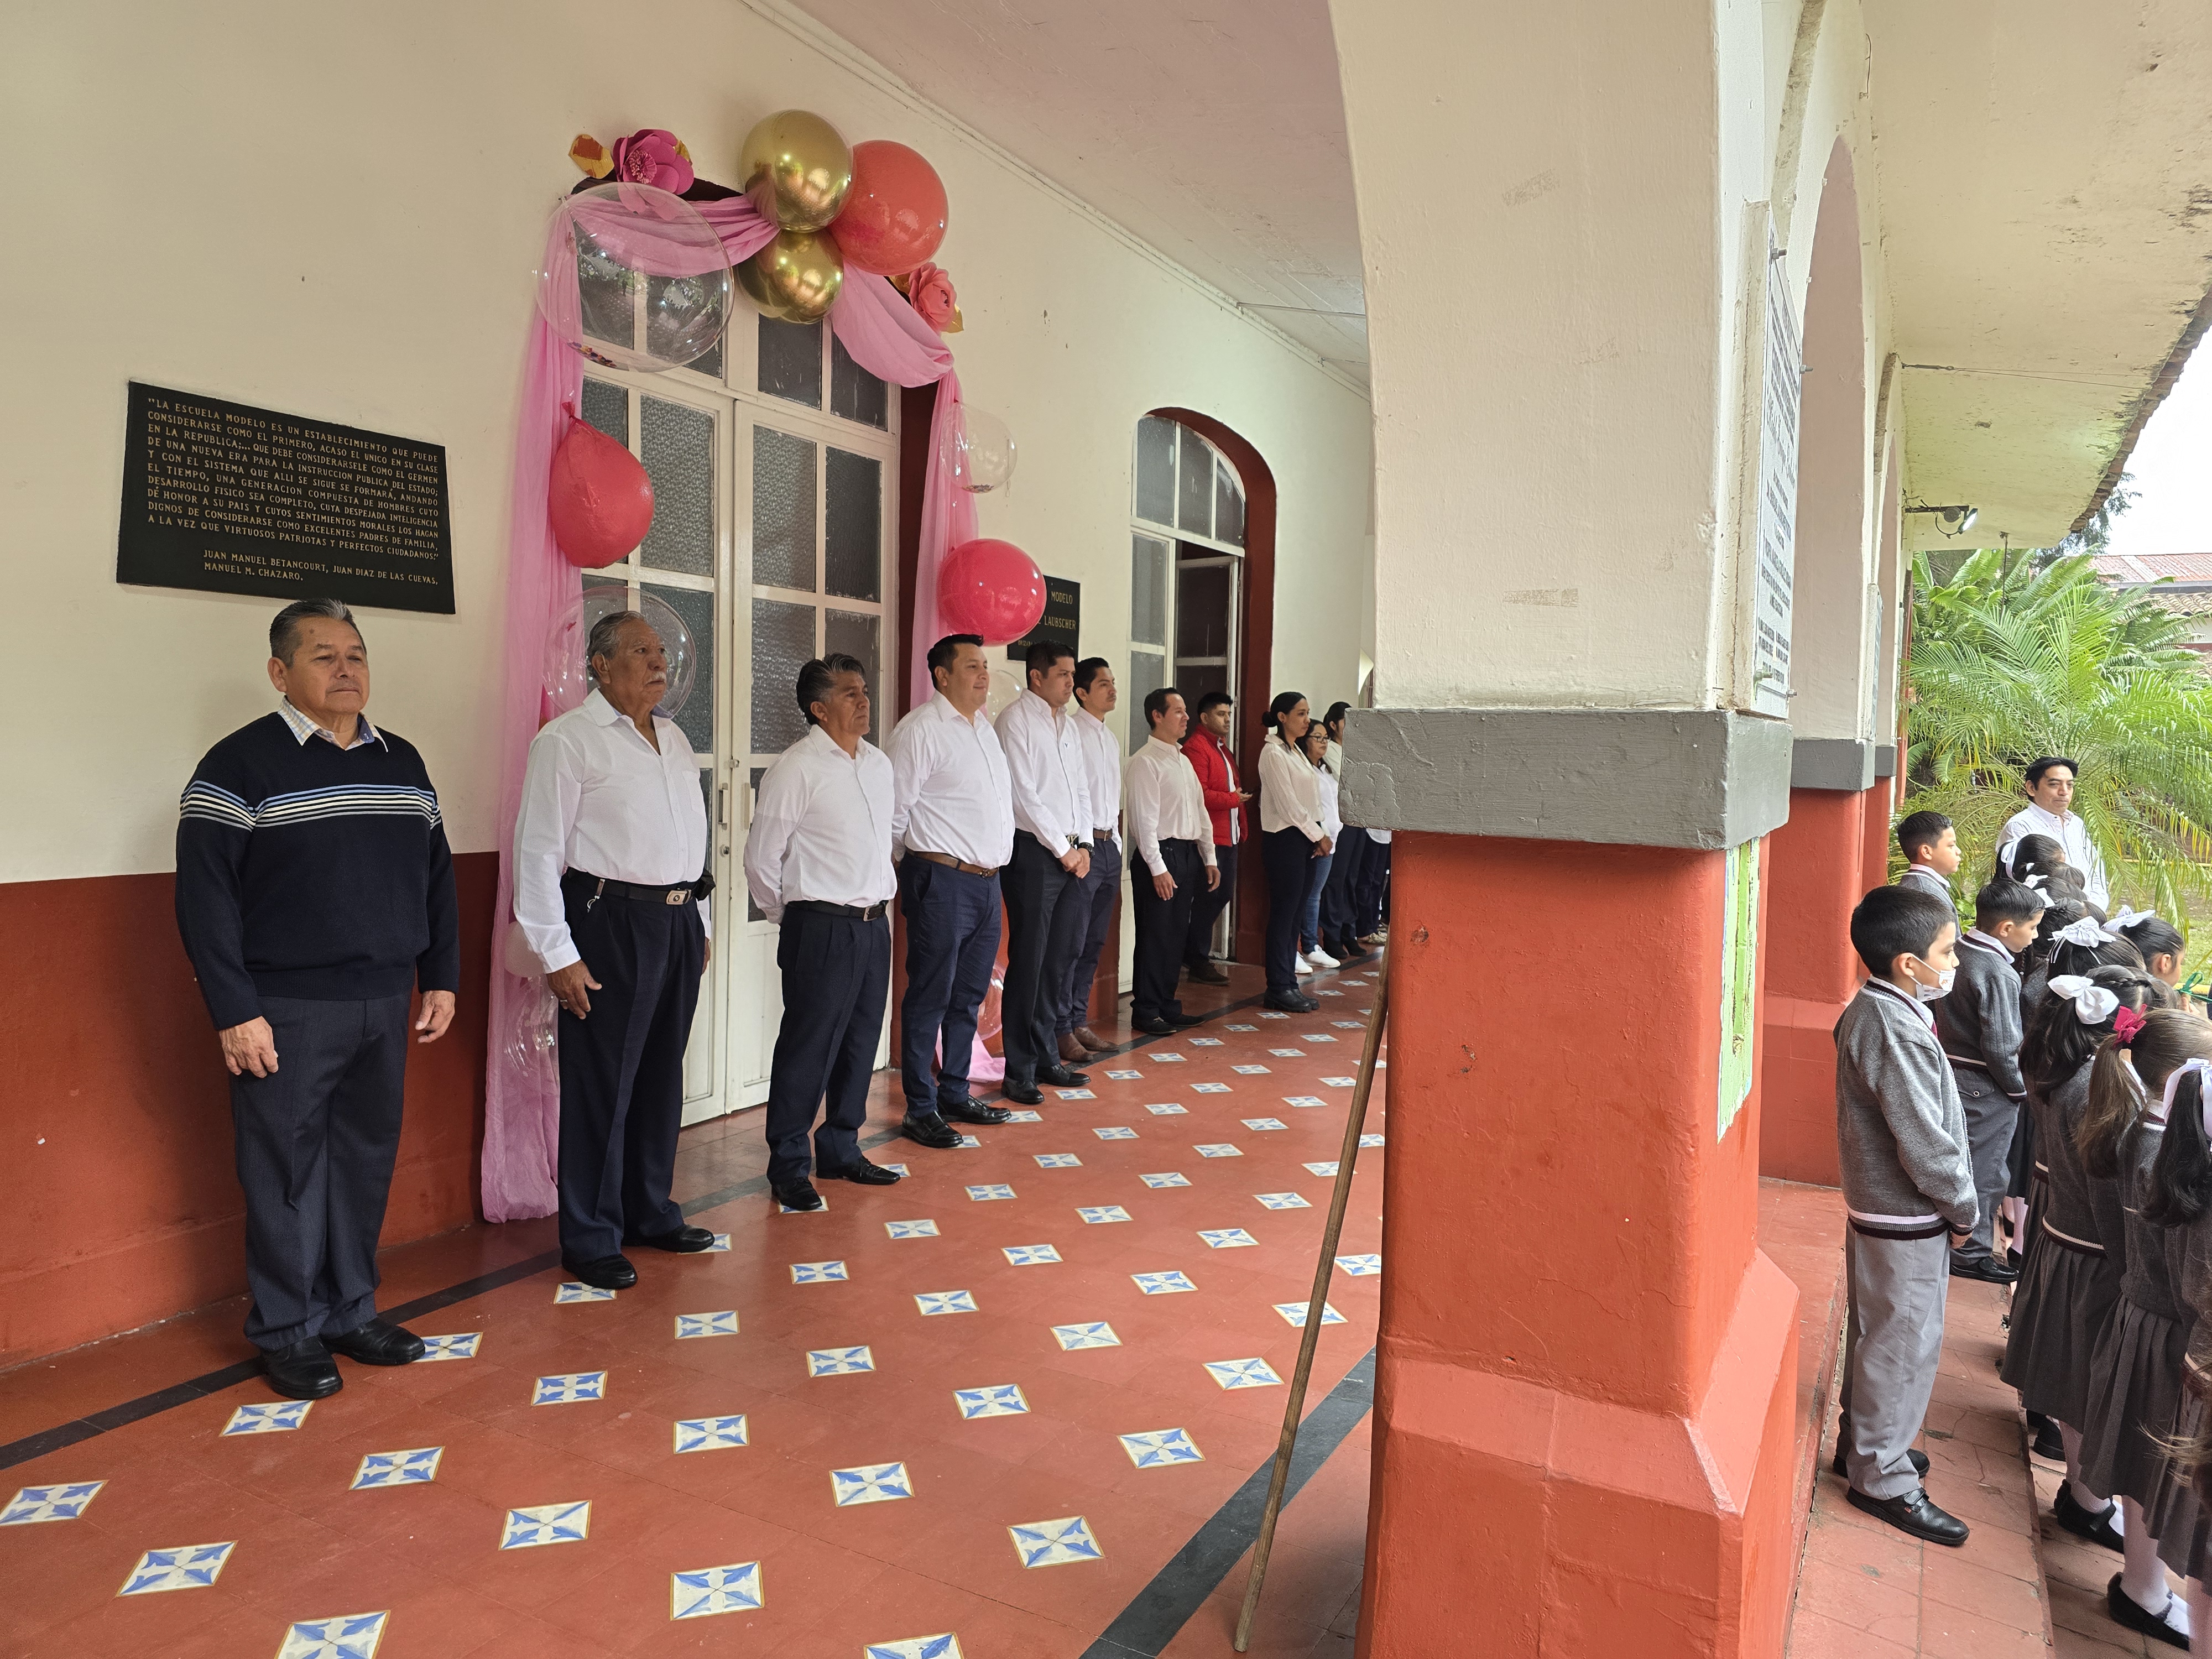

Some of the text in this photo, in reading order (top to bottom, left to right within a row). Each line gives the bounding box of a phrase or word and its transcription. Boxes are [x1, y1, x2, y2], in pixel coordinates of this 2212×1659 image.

[148, 411, 221, 432] CONSIDERARSE
[227, 426, 252, 437] COMO
[258, 432, 267, 441] EL
[273, 435, 315, 451] PRIMERO,
[320, 445, 346, 456] ACASO
[364, 453, 387, 463] UNICO
[417, 463, 437, 473] CLASE
[148, 424, 160, 432] EN
[166, 427, 178, 437] LA
[253, 444, 269, 453] QUE
[273, 447, 292, 457] DEBE
[296, 452, 367, 471] CONSIDERARSELE
[372, 466, 392, 476] COMO
[396, 470, 404, 478] EL
[408, 473, 437, 484] GERMEN
[175, 403, 220, 419] ESCUELA
[226, 414, 265, 428] MODELO
[272, 423, 281, 431] ES
[288, 426, 299, 435] UN
[305, 430, 387, 452] ESTABLECIMIENTO
[392, 448, 408, 456] QUE
[413, 451, 437, 462] PUEDE
[148, 436, 437, 497] DE UNA NUEVA ERA PARA LA INSTRUCCION PUBLICA DEL ESTADO;
[148, 450, 154, 458] Y
[162, 452, 181, 462] CON
[187, 457, 198, 466] EL
[205, 460, 244, 474] SISTEMA
[250, 468, 268, 478] QUE
[274, 472, 293, 482] ALLI
[313, 479, 335, 489] SIGUE
[354, 486, 396, 500] FORMARÁ,
[400, 493, 437, 505] ANDANDO
[148, 463, 159, 472] EL
[166, 466, 209, 481] TIEMPO,
[216, 474, 235, 484] UNA
[241, 479, 301, 495] GENERACION
[309, 490, 358, 504] COMPUESTA
[378, 501, 414, 513] HOMBRES
[419, 508, 438, 516] CUYO
[148, 475, 437, 528] DESARROLLO FISICO SEA COMPLETO, CUYA DESPEJADA INTELIGENCIA
[148, 501, 182, 513] DIGNOS
[188, 507, 199, 516] DE
[205, 510, 272, 526] CONSIDERARSE
[277, 520, 300, 530] COMO
[305, 524, 355, 538] EXCELENTES
[359, 532, 388, 542] PADRES
[405, 538, 437, 551] FAMILIA,
[164, 491, 197, 503] HONOR
[228, 500, 249, 511] PAIS
[265, 507, 291, 517] CUYOS
[296, 511, 356, 526] SENTIMIENTOS
[360, 521, 395, 532] MORALES
[399, 526, 411, 535] LOS
[415, 529, 437, 538] HAGAN
[148, 514, 154, 523] A
[159, 516, 172, 525] LA
[178, 518, 195, 528] VEZ
[201, 522, 219, 531] QUE
[225, 525, 275, 539] VIRTUOSOS
[279, 533, 326, 545] PATRIOTAS
[340, 540, 383, 552] PERFECTOS
[204, 550, 226, 560] JUAN
[232, 554, 266, 565] MANUEL
[271, 558, 328, 573] BETANCOURT,
[333, 565, 352, 574] JUAN
[356, 568, 374, 577] DIAZ
[390, 572, 404, 580] LAS
[408, 575, 437, 585] CUEVAS,
[205, 562, 303, 581] MANUEL M. CHAZARO.
[1044, 615, 1076, 630] LAUBSCHER
[1051, 591, 1073, 604] MODELO
